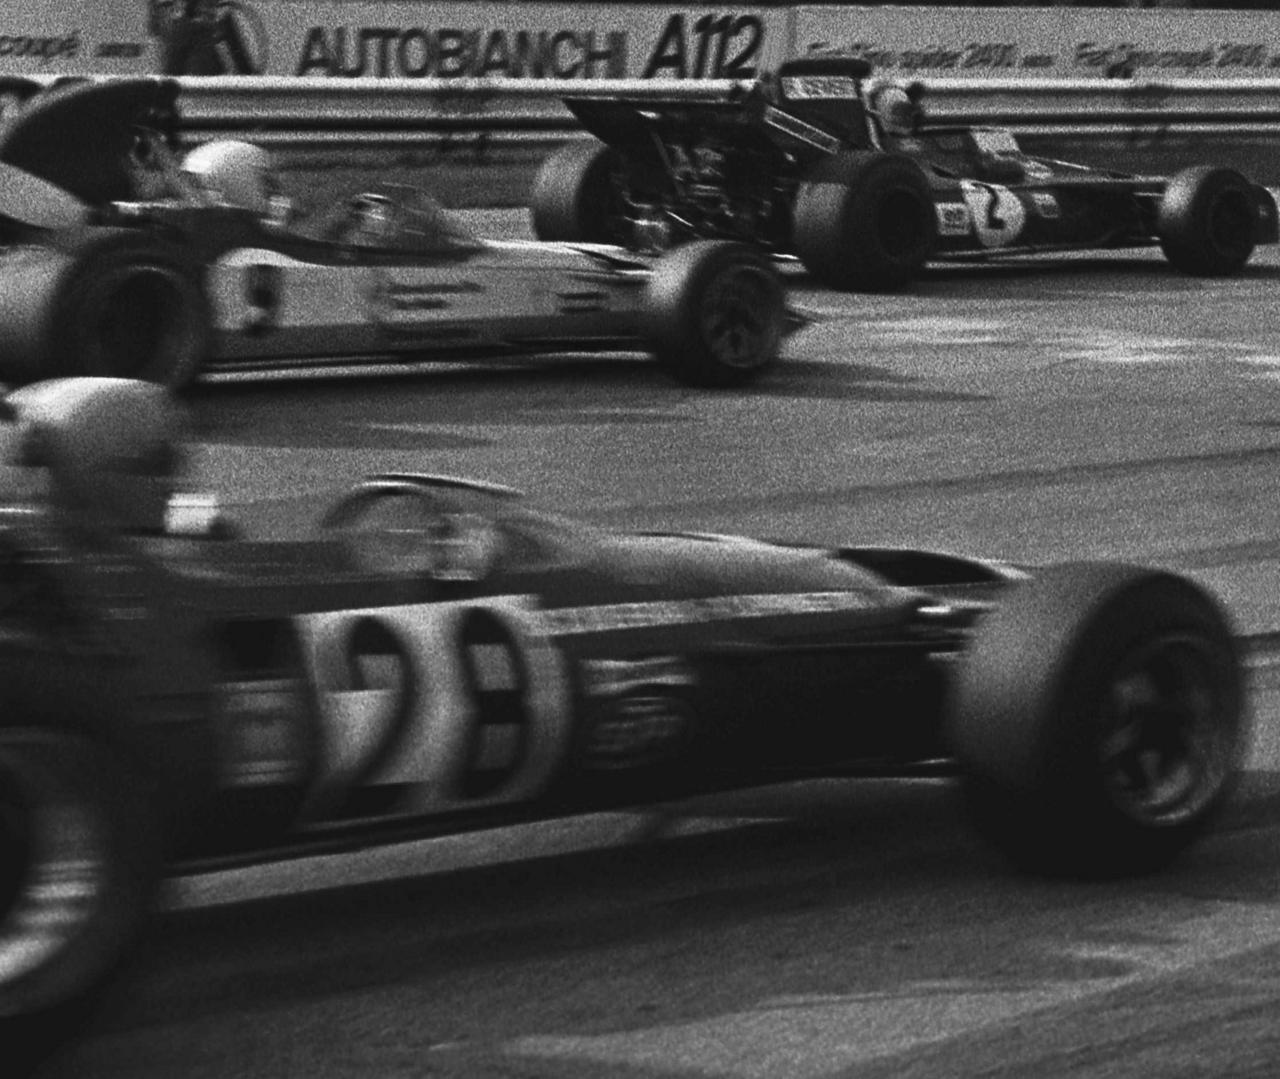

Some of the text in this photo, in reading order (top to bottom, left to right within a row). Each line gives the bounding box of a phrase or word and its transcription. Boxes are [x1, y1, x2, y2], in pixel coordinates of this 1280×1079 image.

[641, 13, 764, 79] A112
[971, 181, 1005, 230] 2
[312, 605, 532, 817] 28
